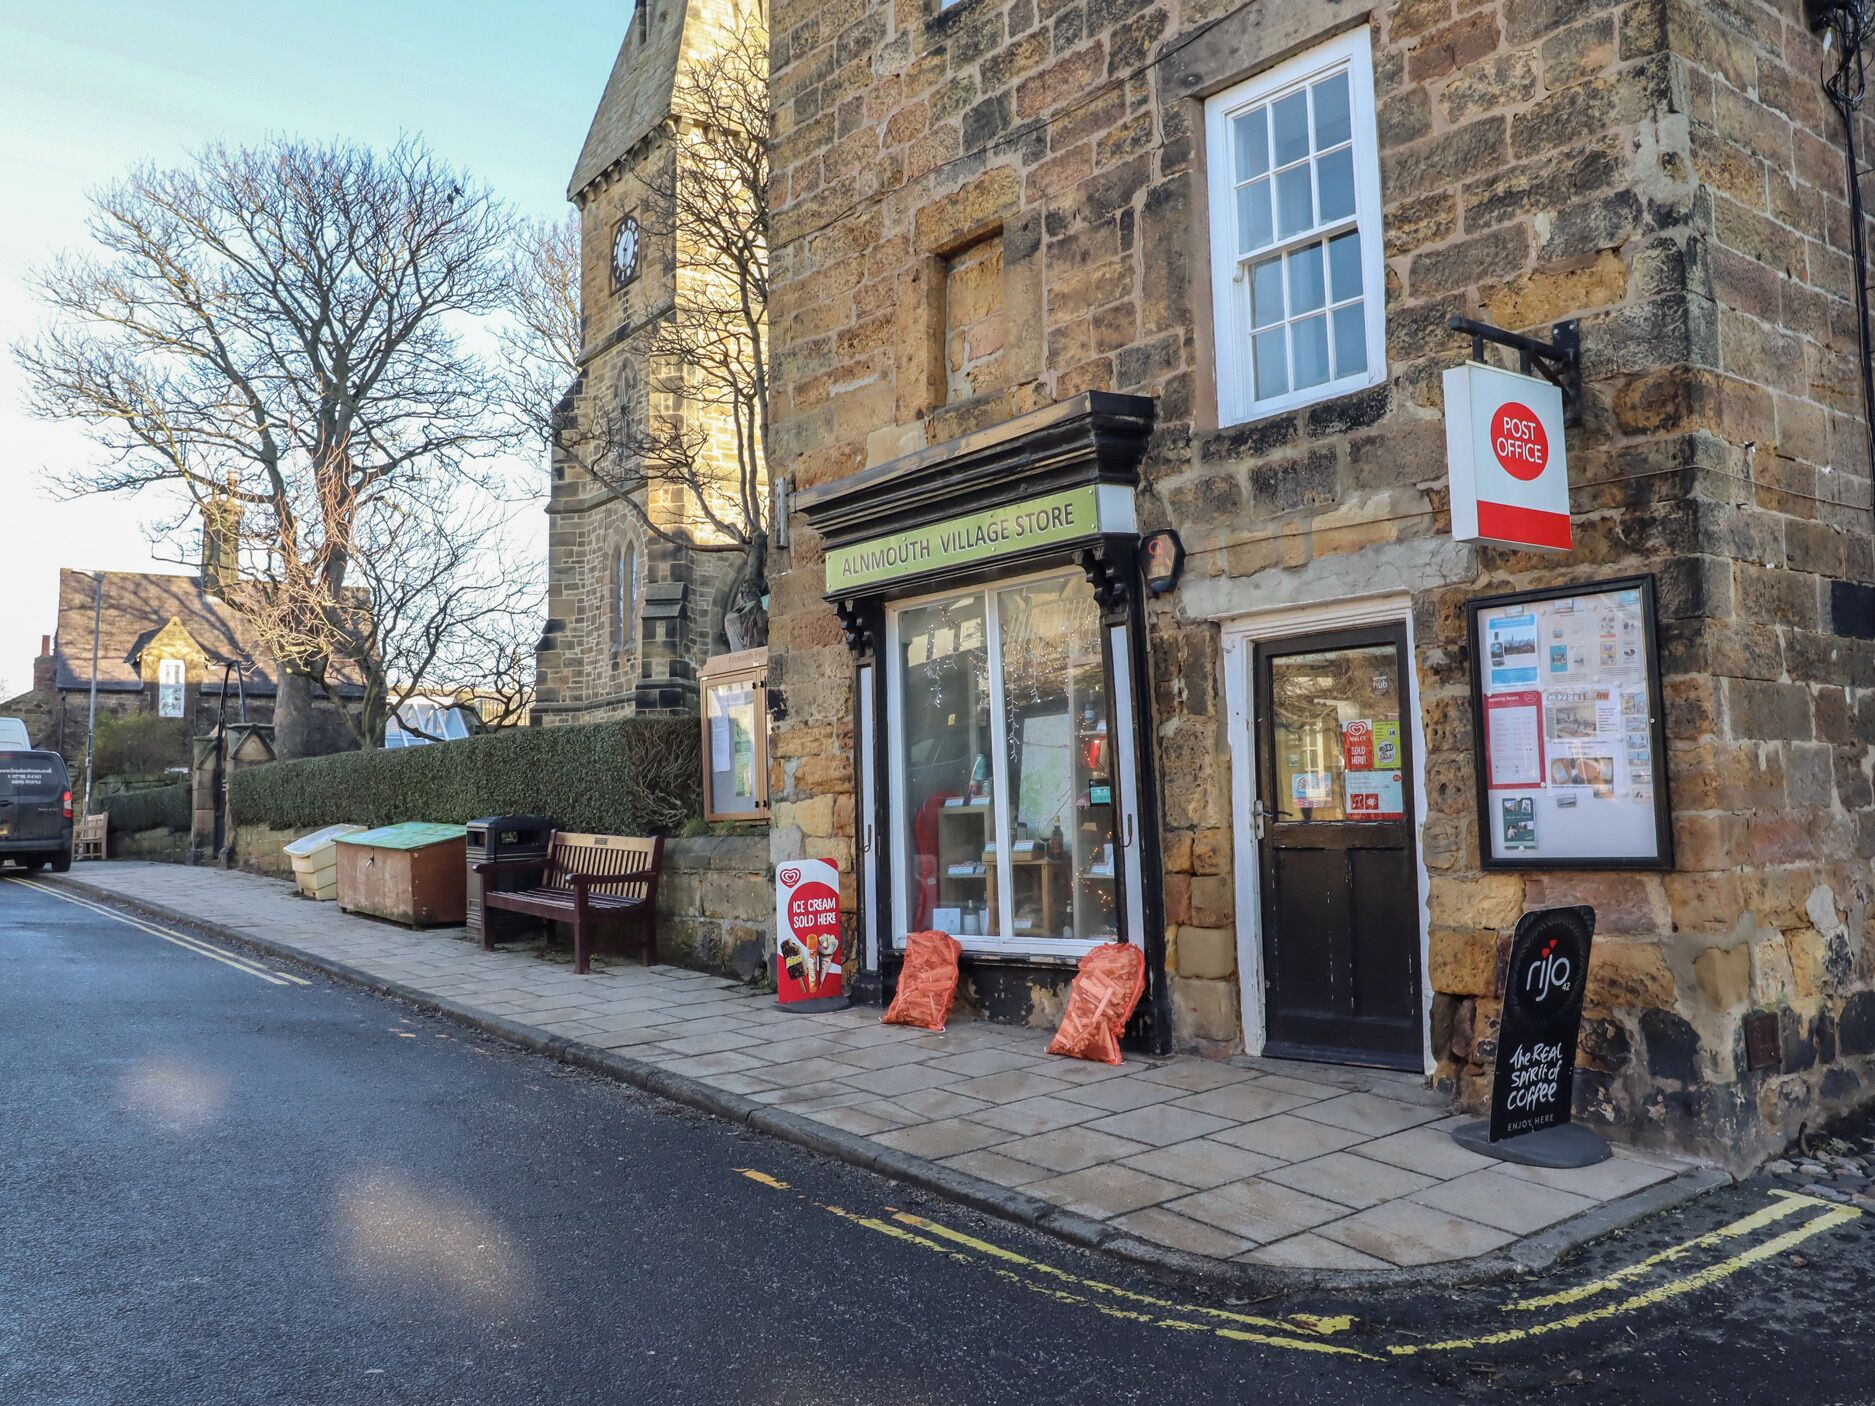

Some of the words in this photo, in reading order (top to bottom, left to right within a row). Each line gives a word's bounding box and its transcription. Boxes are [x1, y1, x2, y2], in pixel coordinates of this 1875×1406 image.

[1504, 416, 1536, 440] POST
[1497, 437, 1543, 464] OFFICE
[842, 537, 930, 577] ALNMOUTH
[939, 518, 1009, 554] VILLAGE
[1015, 503, 1074, 538] STORE
[1546, 691, 1588, 702] GAZETTE
[1351, 746, 1366, 755] SOLD
[793, 900, 805, 913] ICE
[808, 897, 836, 911] CREAM
[794, 916, 815, 929] SOLD
[818, 912, 836, 925] HERE
[1526, 954, 1570, 1002] rijo
[1548, 1060, 1562, 1081] of
[1534, 1113, 1555, 1125] HERE
